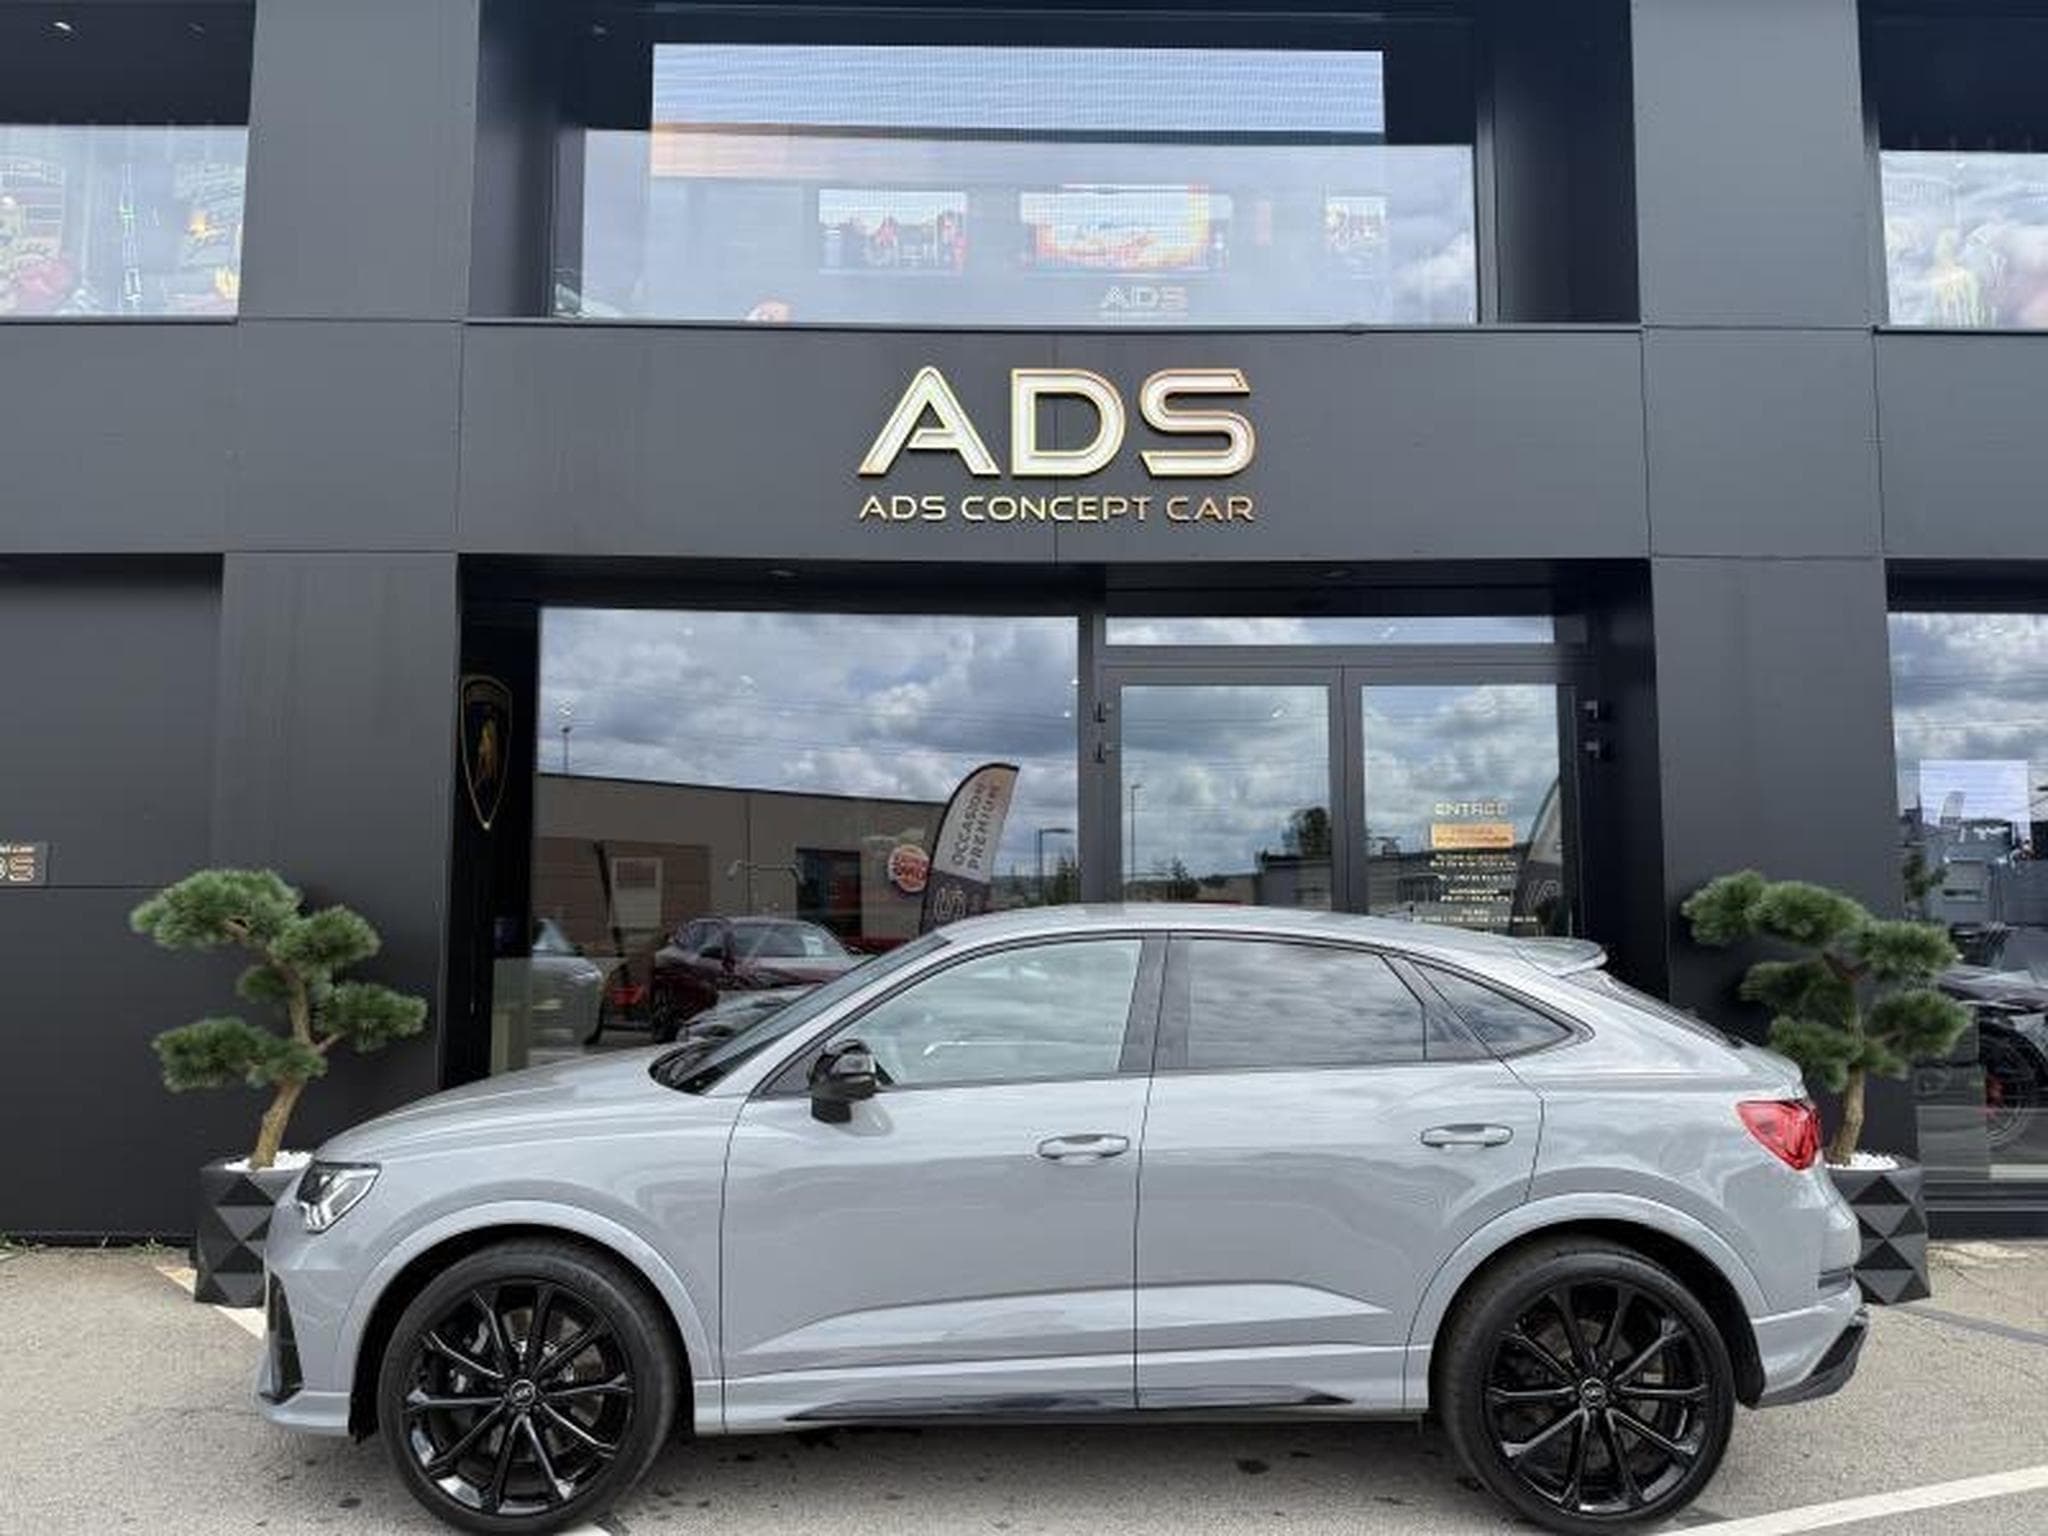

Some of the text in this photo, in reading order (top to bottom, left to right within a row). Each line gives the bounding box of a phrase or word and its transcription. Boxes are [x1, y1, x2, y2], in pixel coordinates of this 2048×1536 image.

[858, 365, 1257, 478] ADS
[859, 496, 1255, 522] ADS CONCEPT CAR
